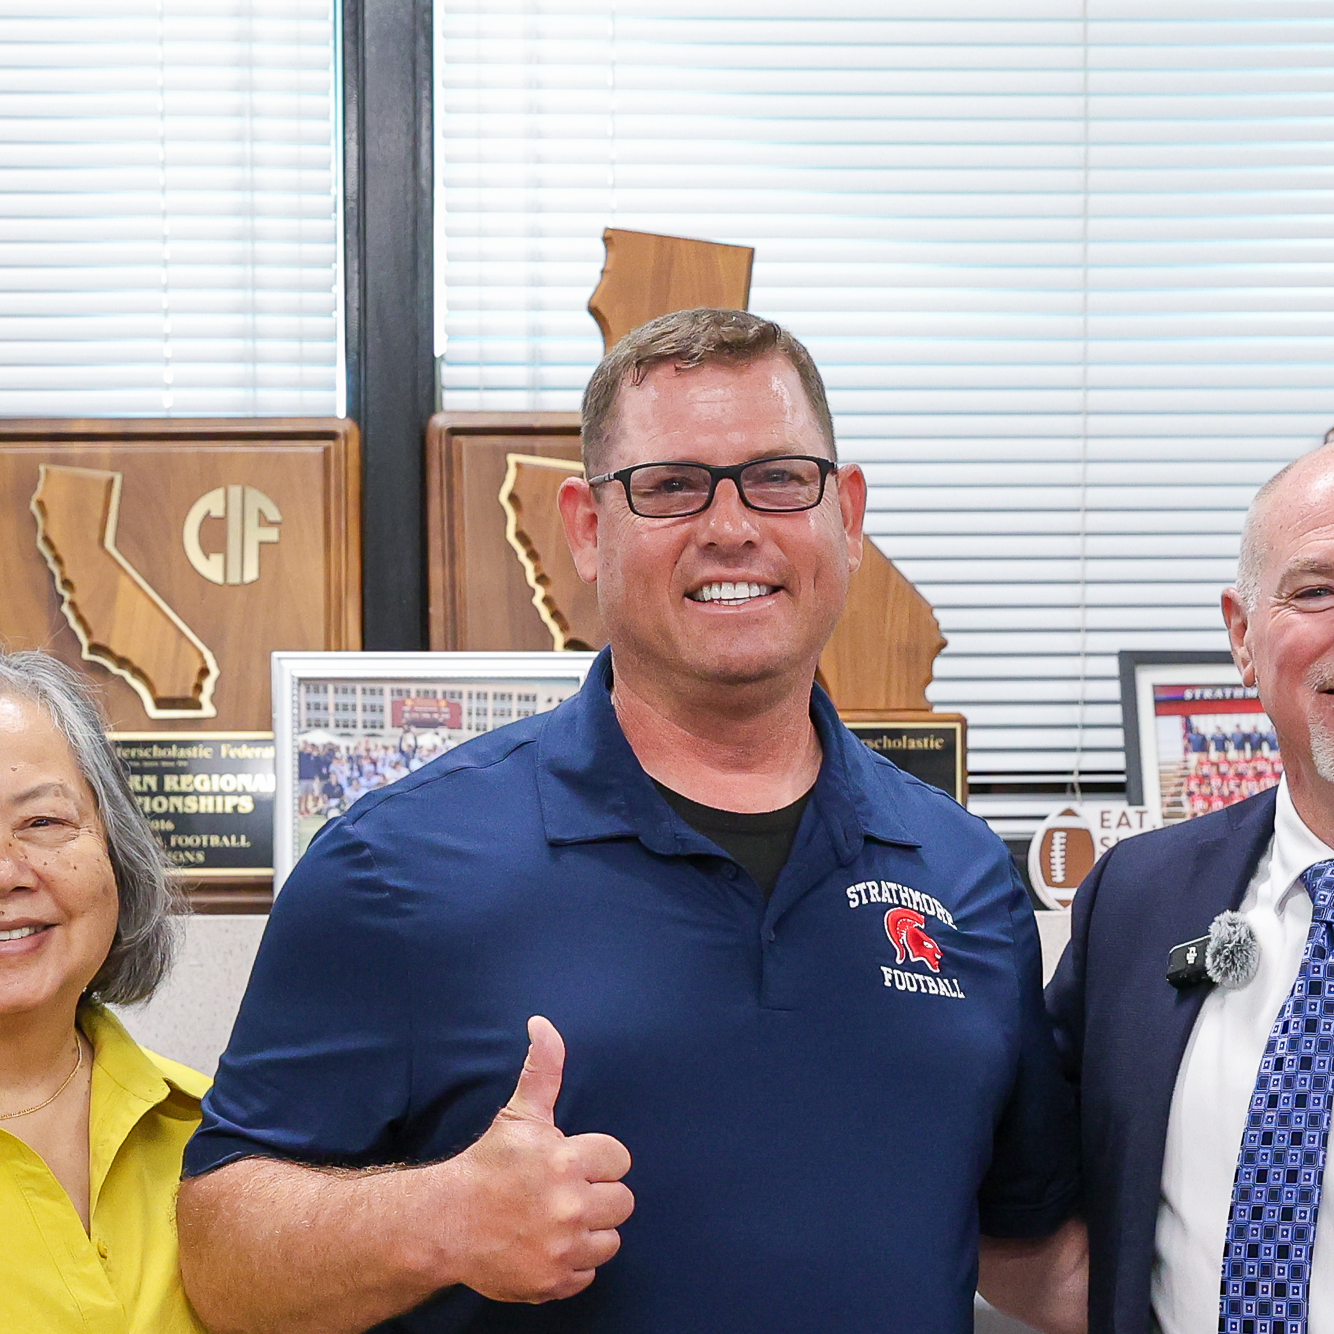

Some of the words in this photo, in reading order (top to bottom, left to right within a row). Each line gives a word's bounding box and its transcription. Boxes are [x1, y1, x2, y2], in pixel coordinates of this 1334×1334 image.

[117, 744, 213, 759] terscholastic
[1100, 810, 1156, 829] EAT.
[170, 835, 251, 848] FOOTBALL
[880, 966, 965, 998] FOOTBALL
